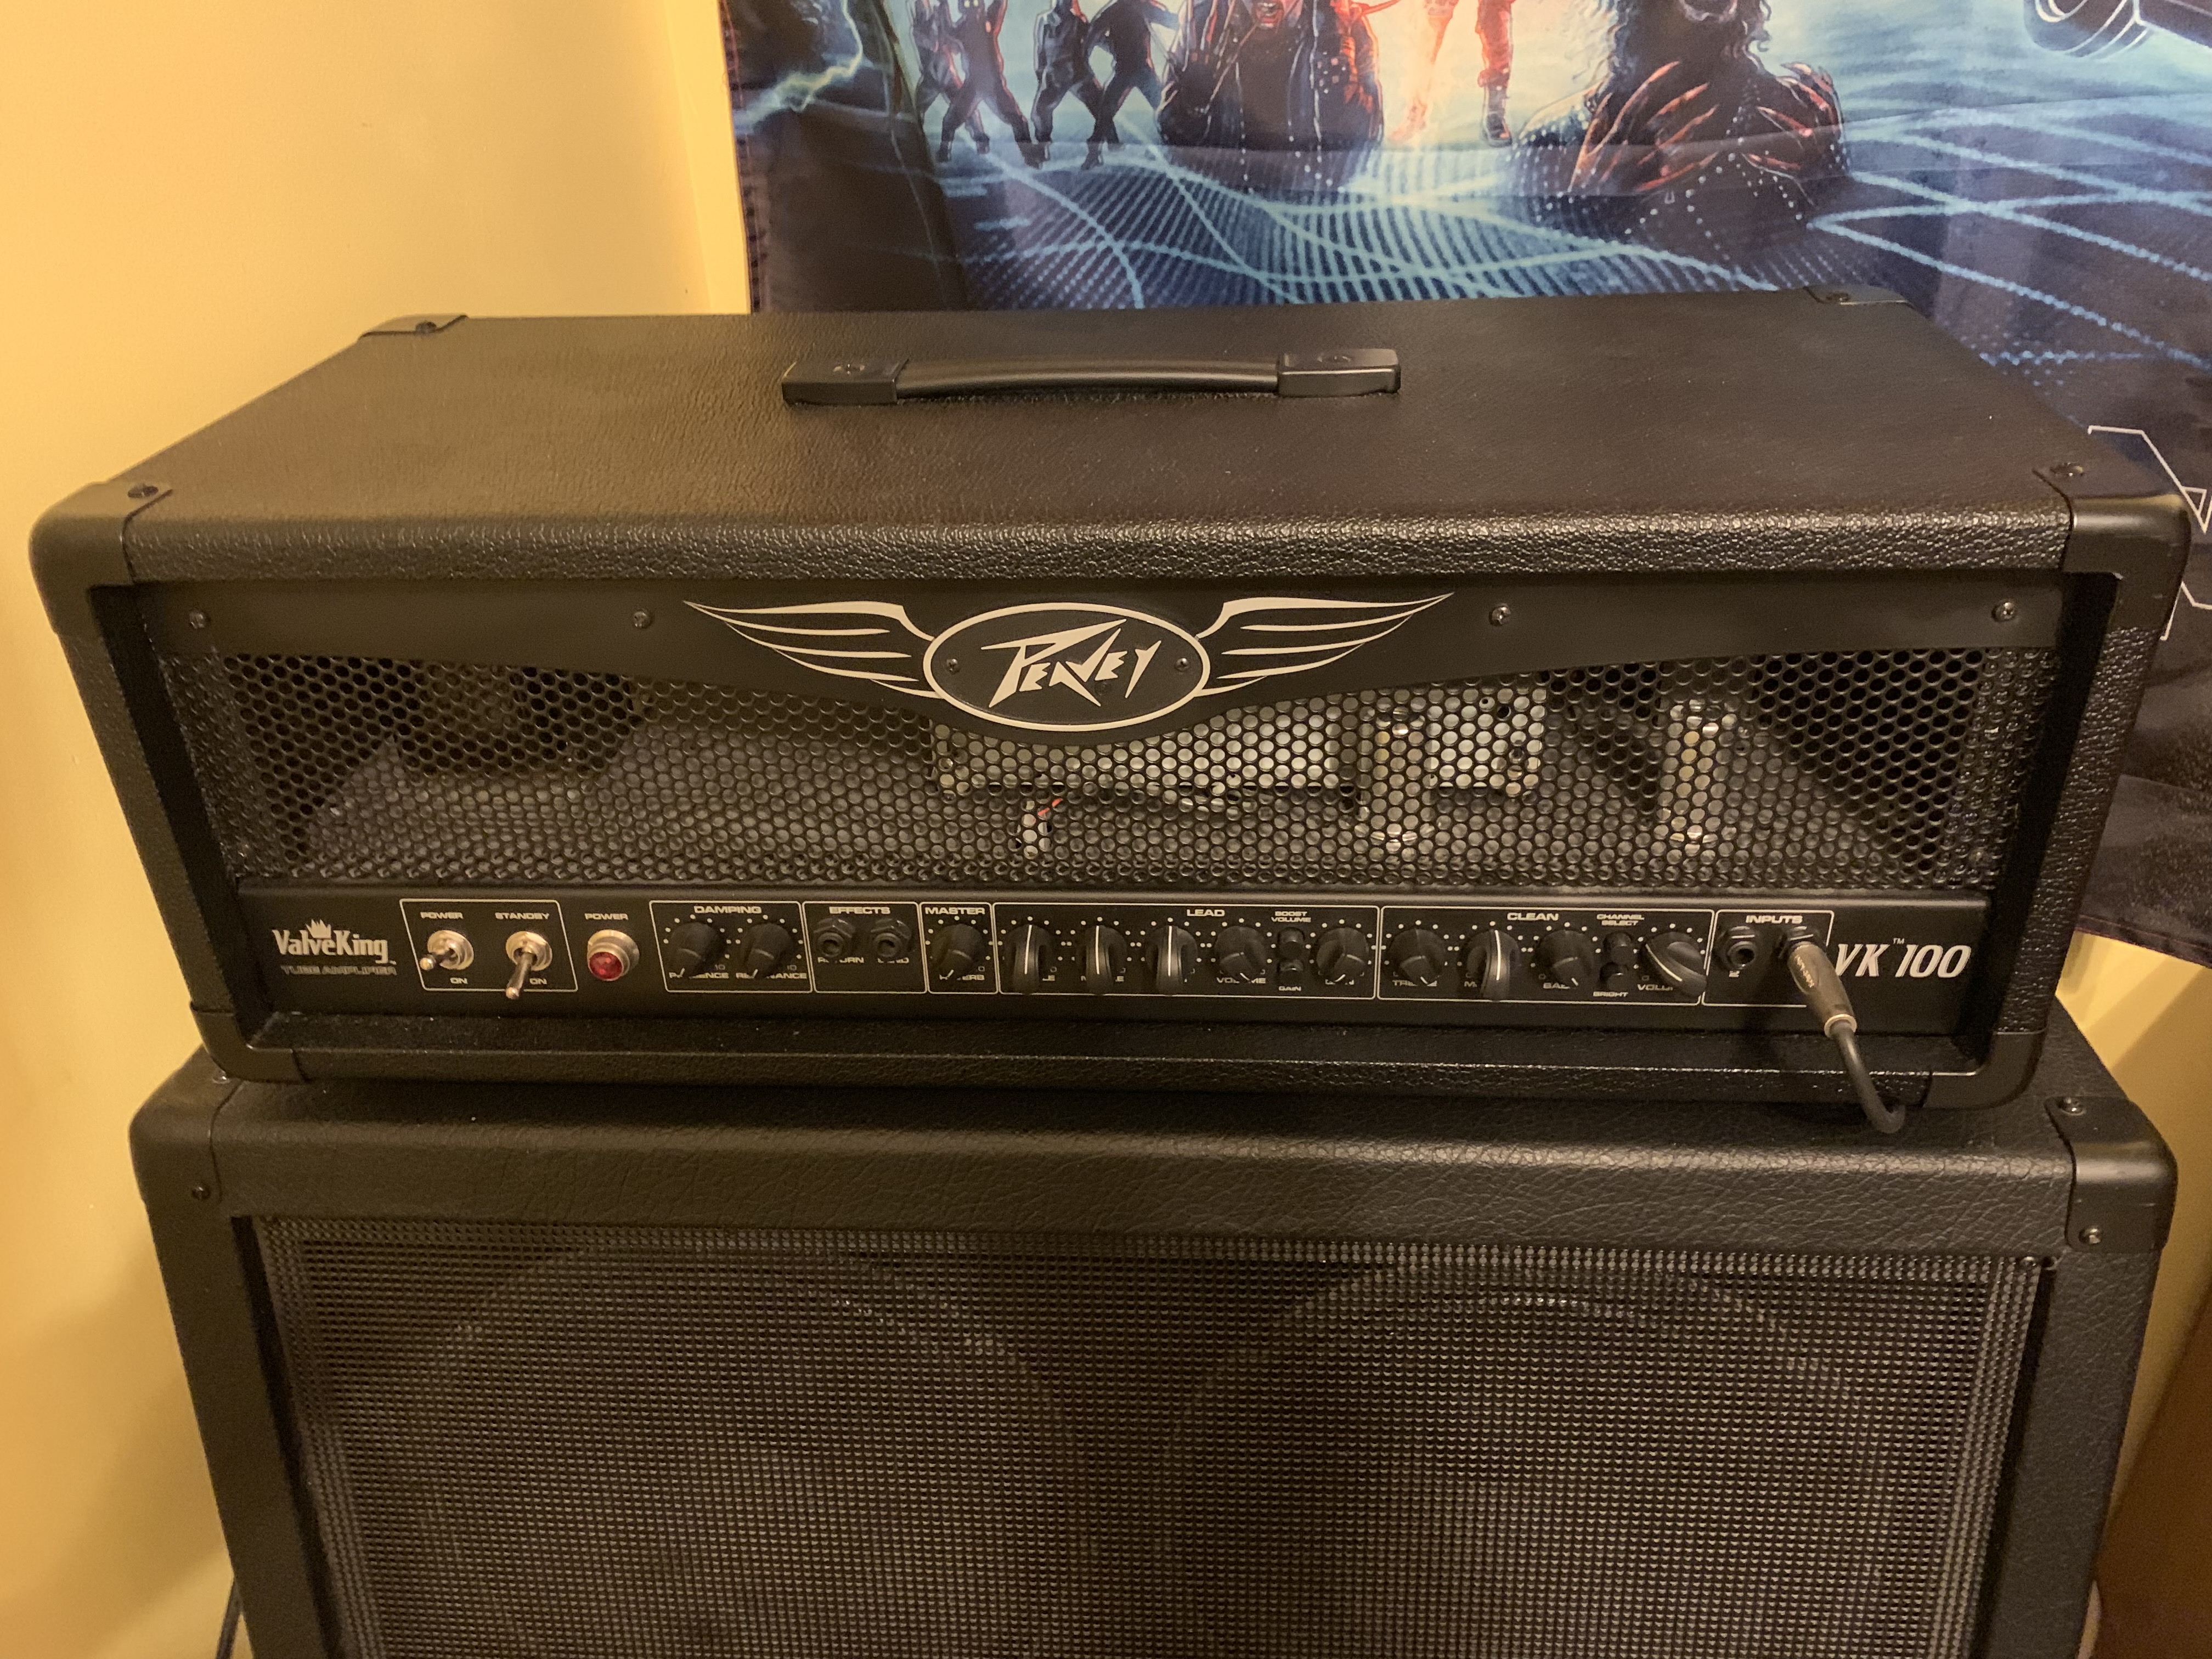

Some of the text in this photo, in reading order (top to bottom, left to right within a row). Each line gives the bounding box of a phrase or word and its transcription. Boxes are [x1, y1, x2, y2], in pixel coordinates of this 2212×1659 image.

[694, 906, 762, 914] DAMPING
[829, 906, 891, 915] EFFECTS
[925, 907, 985, 915] MASTER
[1187, 909, 1226, 917] LEAD
[420, 911, 464, 919] POWER
[495, 912, 550, 920] STANDBY
[585, 912, 629, 921] POWER
[1507, 912, 1559, 921] CLEAN
[1745, 915, 1803, 924] INPUTS
[272, 929, 389, 964] ValveKing
[1835, 944, 1889, 977] VK
[1895, 945, 1971, 978] 100
